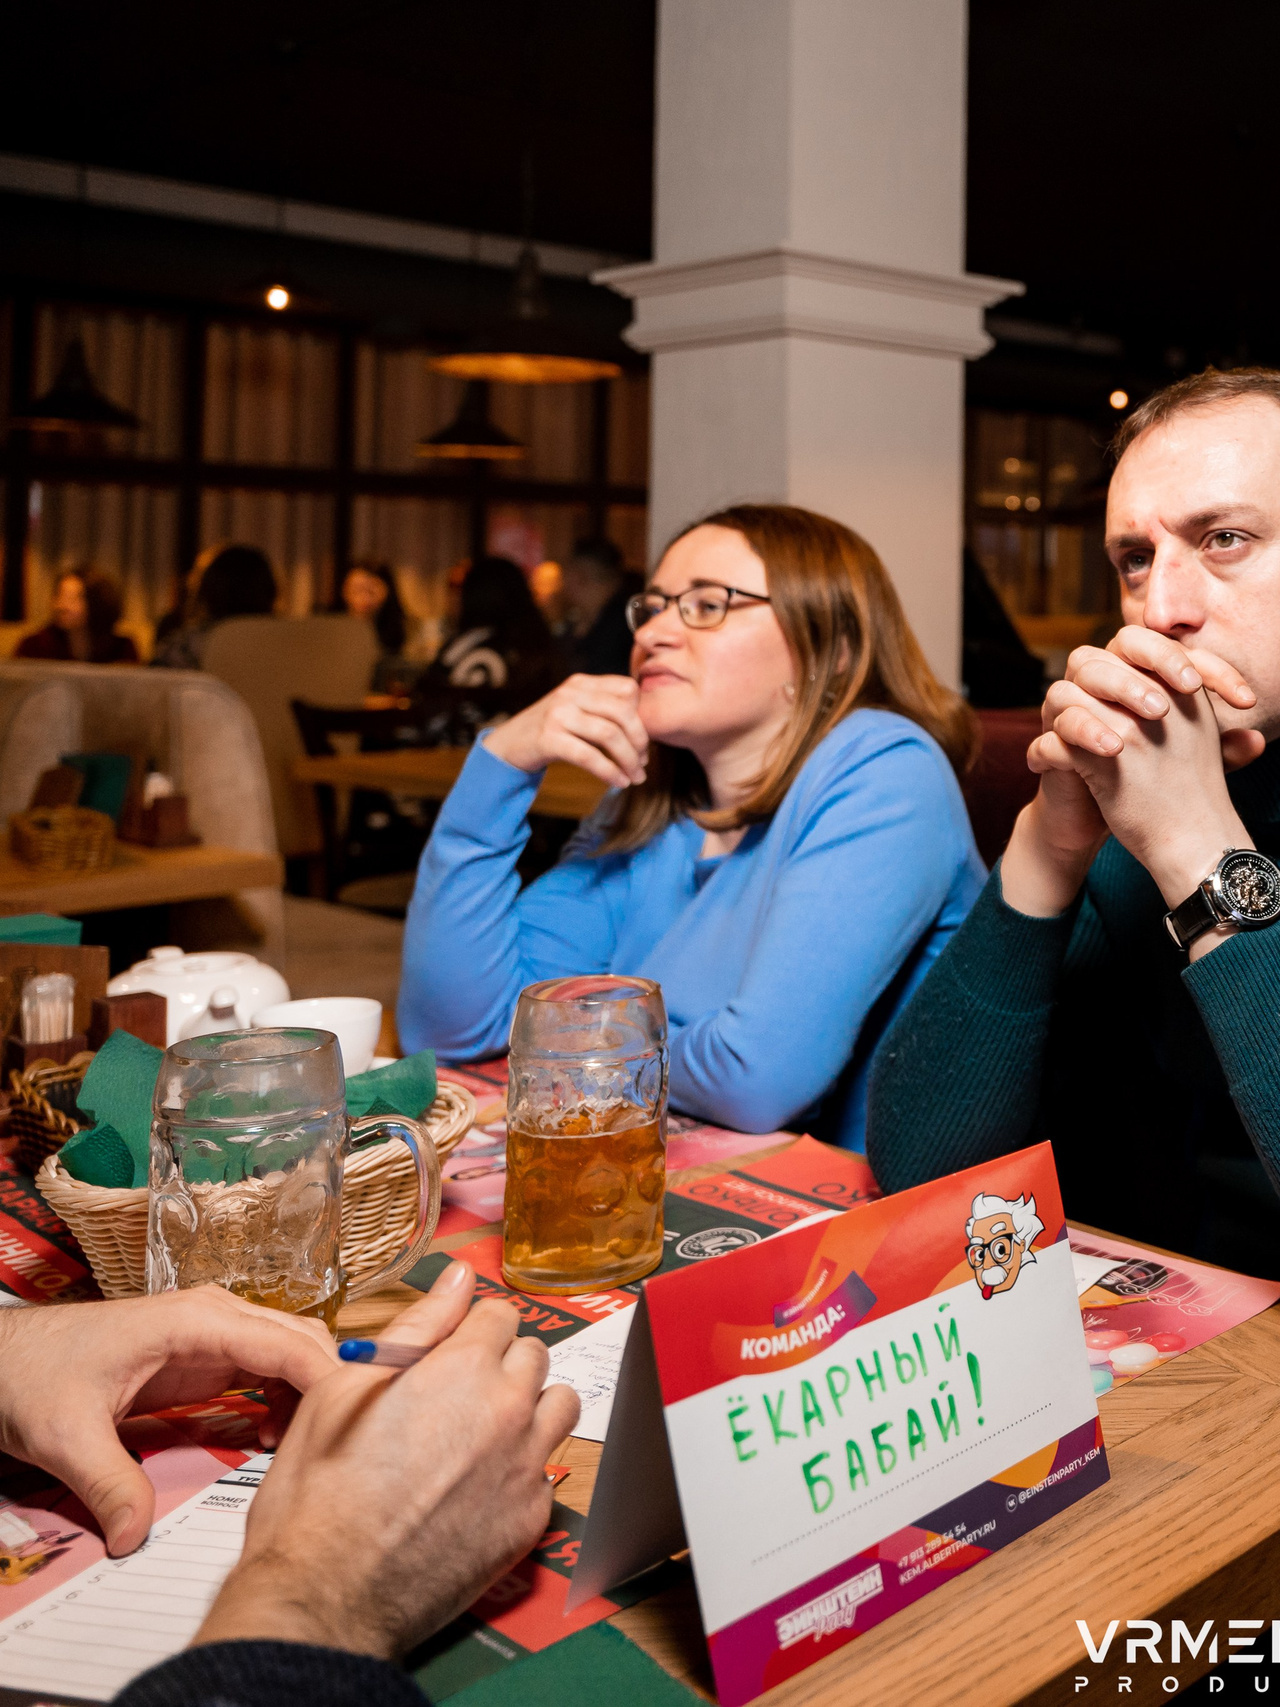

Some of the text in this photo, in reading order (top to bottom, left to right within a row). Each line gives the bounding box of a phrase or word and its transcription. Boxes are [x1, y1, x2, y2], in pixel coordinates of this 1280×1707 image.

[740, 1304, 846, 1360] КОМАНДА:
[727, 1302, 962, 1463] ЁКАРНЫЙ
[802, 1351, 986, 1515] БАБАЙ!
[207, 1494, 248, 1504] НОМЕР
[1018, 1446, 1101, 1504] @EINSTEINPARTY_KEM
[200, 1501, 239, 1509] ВОПРОСА
[954, 1522, 967, 1537] 54
[154, 1530, 171, 1539] 2
[899, 1519, 997, 1585] KEM.ALBERTPARTY.RU
